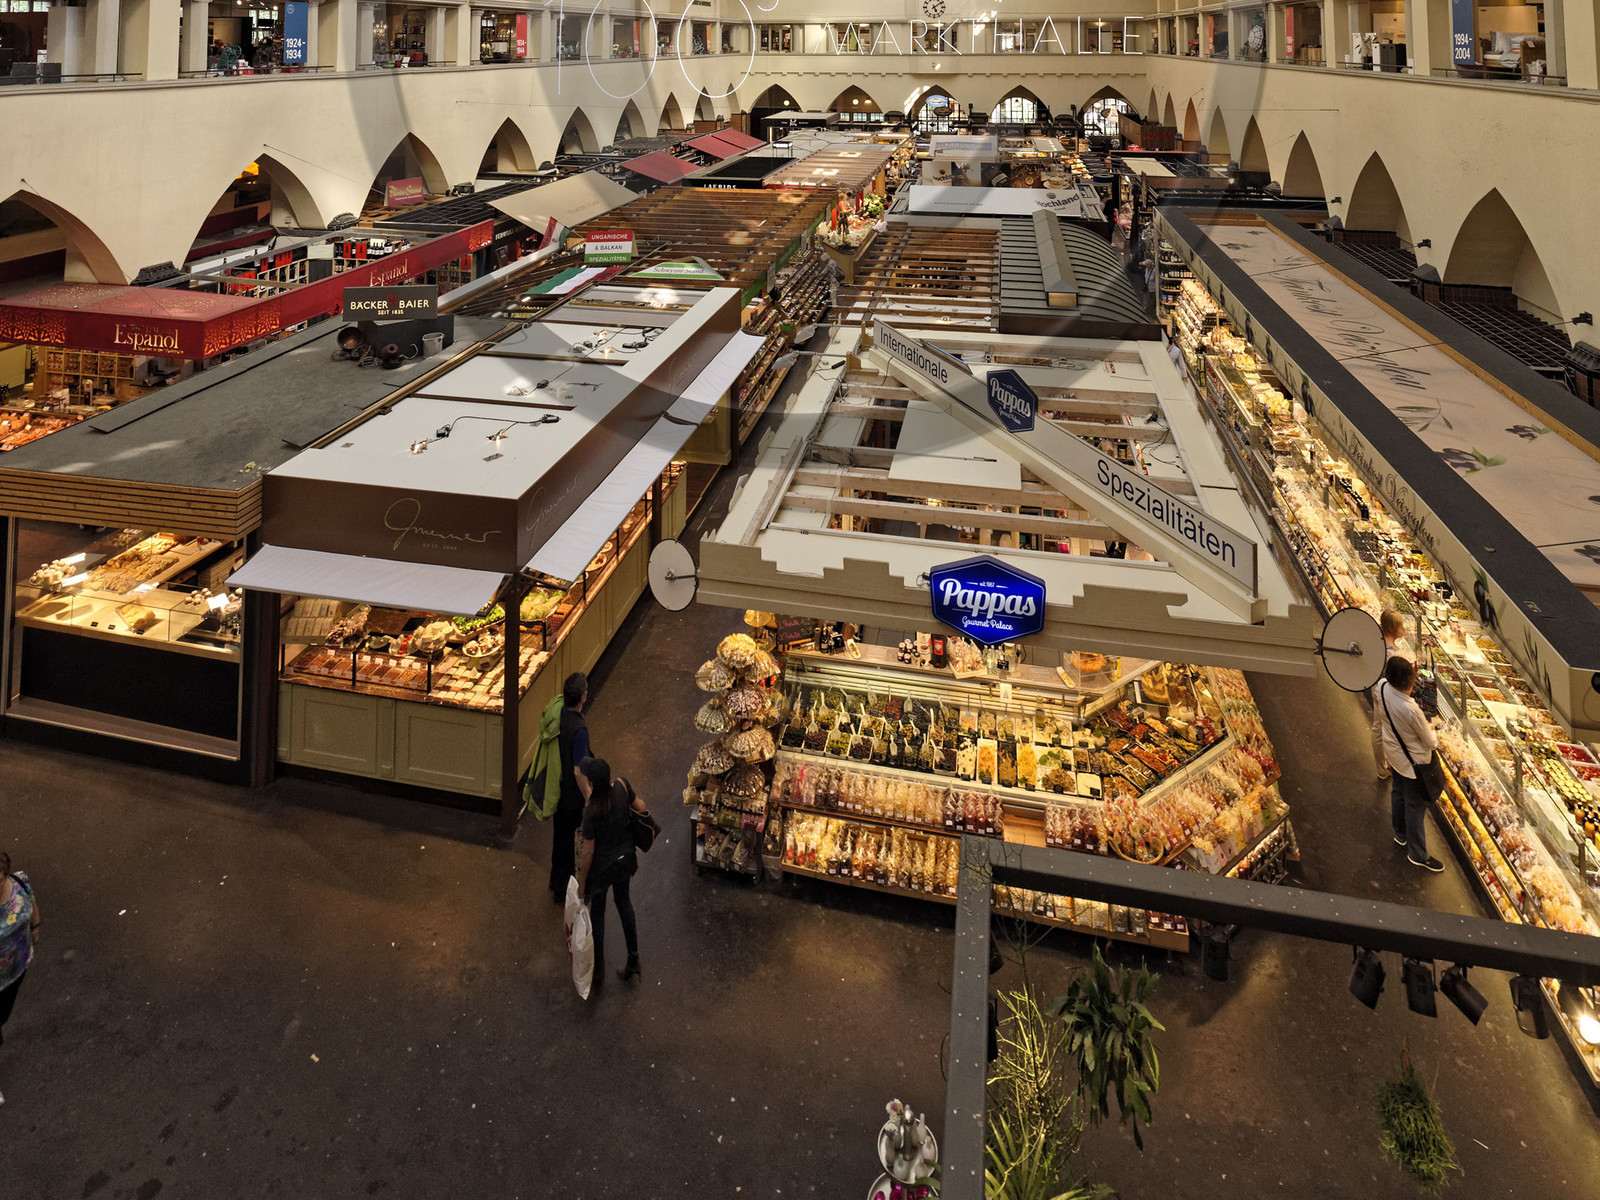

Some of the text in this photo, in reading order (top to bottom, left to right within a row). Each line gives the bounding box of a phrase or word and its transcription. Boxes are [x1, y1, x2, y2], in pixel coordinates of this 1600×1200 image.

[286, 38, 306, 49] 1924-
[814, 15, 1144, 56] MARKTHALLE
[286, 49, 302, 60] 1934
[1455, 47, 1471, 60] 2004
[1035, 192, 1080, 209] Hochland
[350, 299, 430, 310] BÄCKER BAIER
[880, 327, 949, 384] Internationale
[990, 377, 1031, 418] Pappas
[1097, 459, 1236, 568] Spezialitäten
[939, 578, 1036, 619] Pappas
[961, 615, 1014, 631] Gourmet Palace
